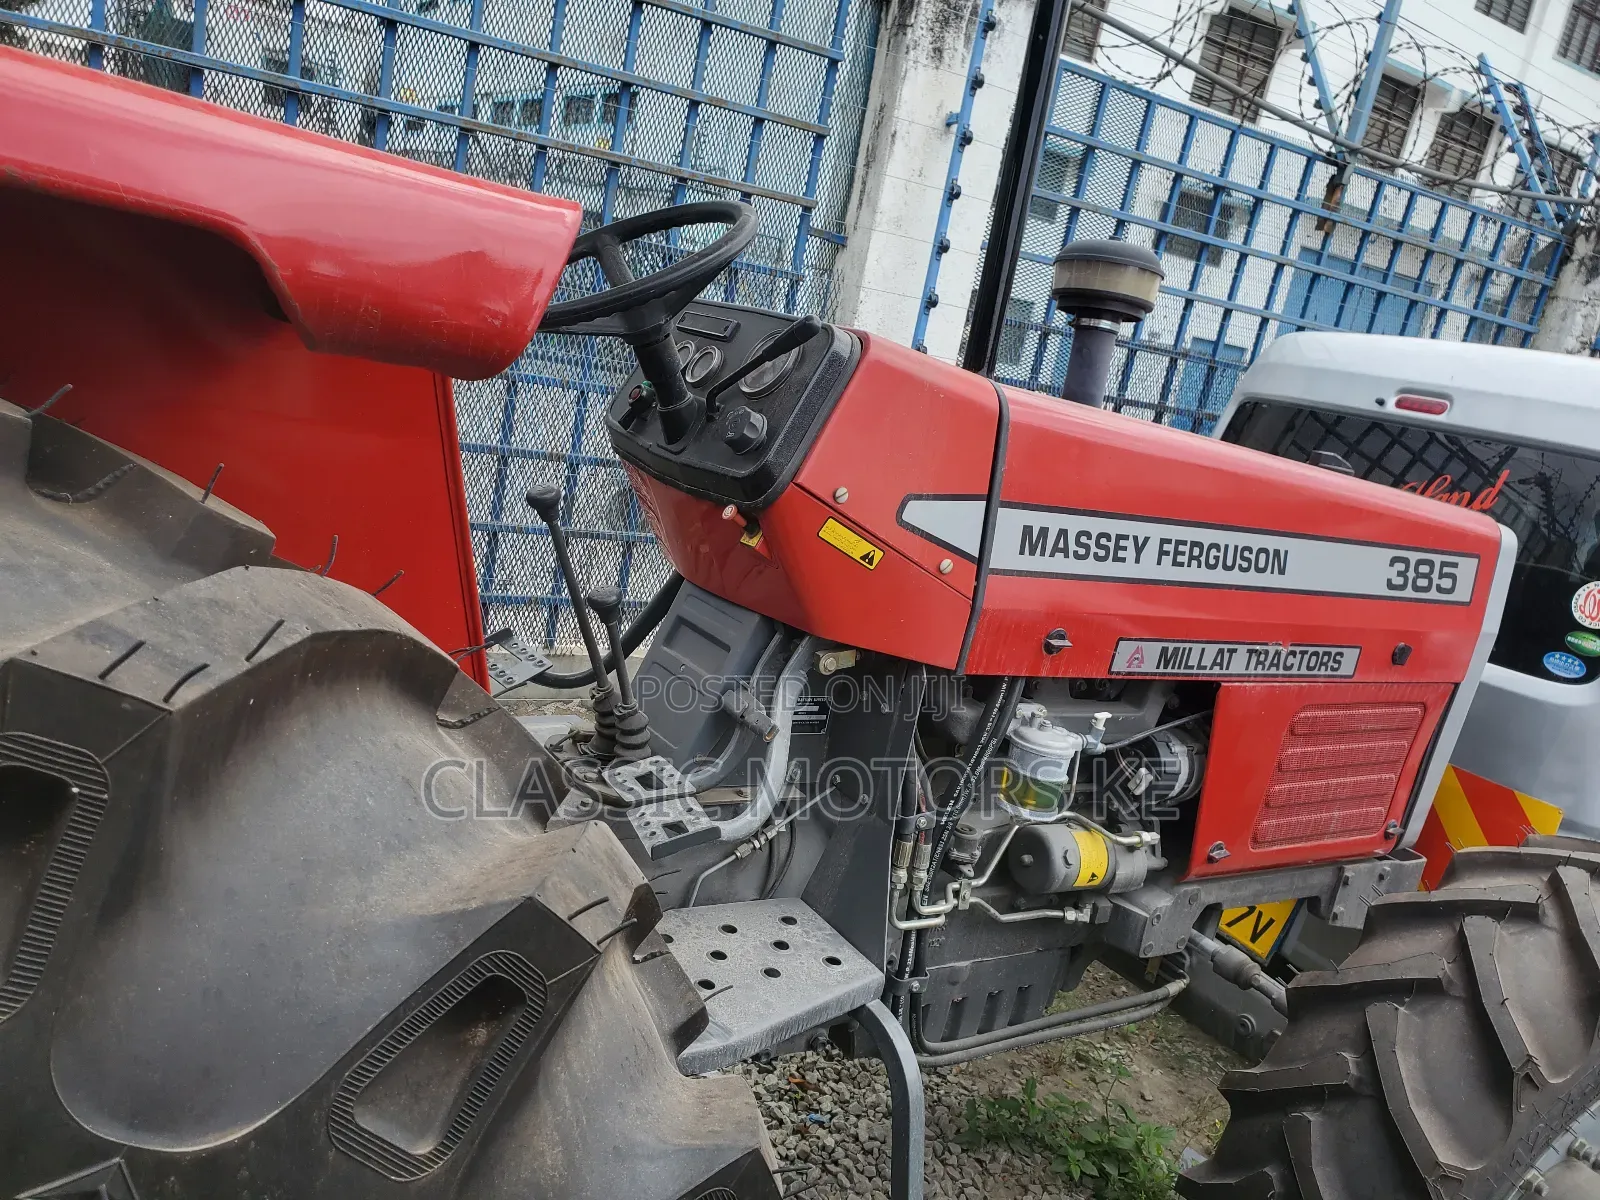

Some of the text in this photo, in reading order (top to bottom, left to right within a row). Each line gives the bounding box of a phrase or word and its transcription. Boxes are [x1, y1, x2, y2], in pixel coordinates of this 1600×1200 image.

[1018, 524, 1289, 576] MASSEY FERGUSON
[1386, 555, 1459, 595] 385
[1155, 646, 1344, 672] MILLAT TRACTORS
